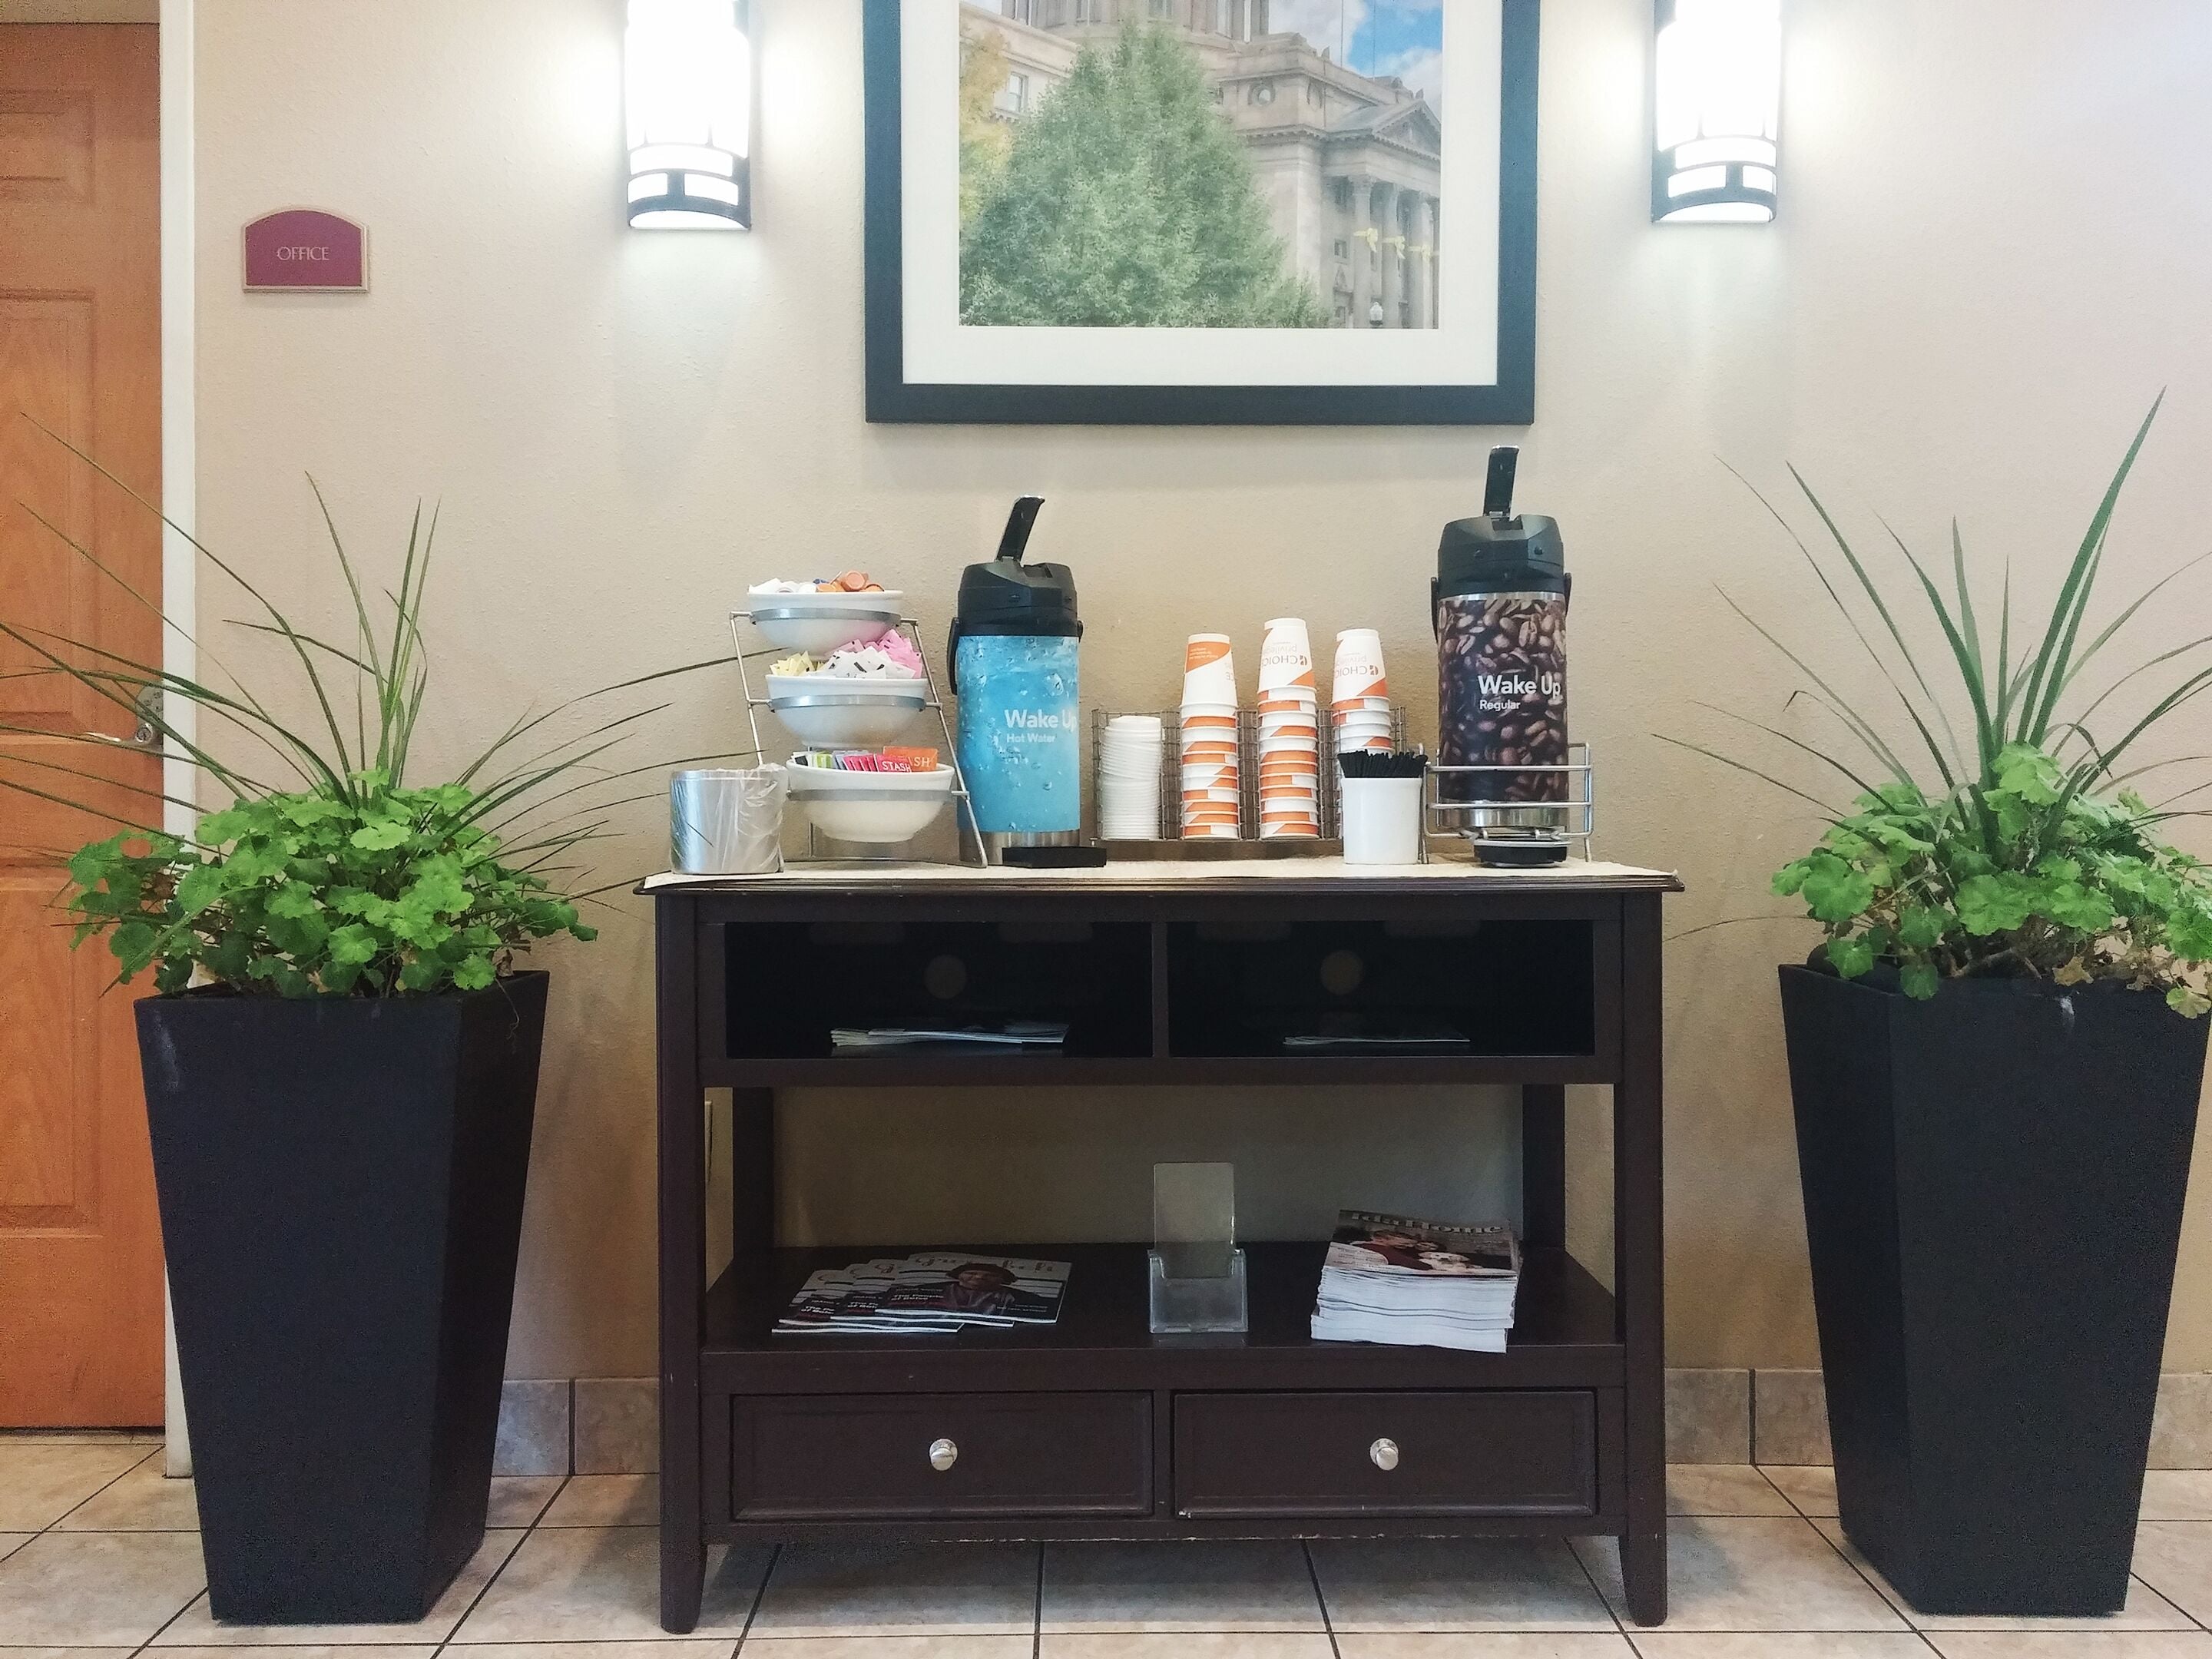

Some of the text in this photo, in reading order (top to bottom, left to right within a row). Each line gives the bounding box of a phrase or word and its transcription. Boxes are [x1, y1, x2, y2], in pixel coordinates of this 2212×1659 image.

[276, 247, 329, 260] OFFICE
[1261, 655, 1298, 667] CHOIC
[1335, 665, 1368, 679] CHOIC
[1478, 674, 1561, 700] Wake Up
[1479, 699, 1522, 711] Regular
[1004, 709, 1078, 732] Wake Up
[1007, 733, 1056, 743] Hot Water
[882, 760, 912, 772] STASH
[909, 756, 931, 767] SH
